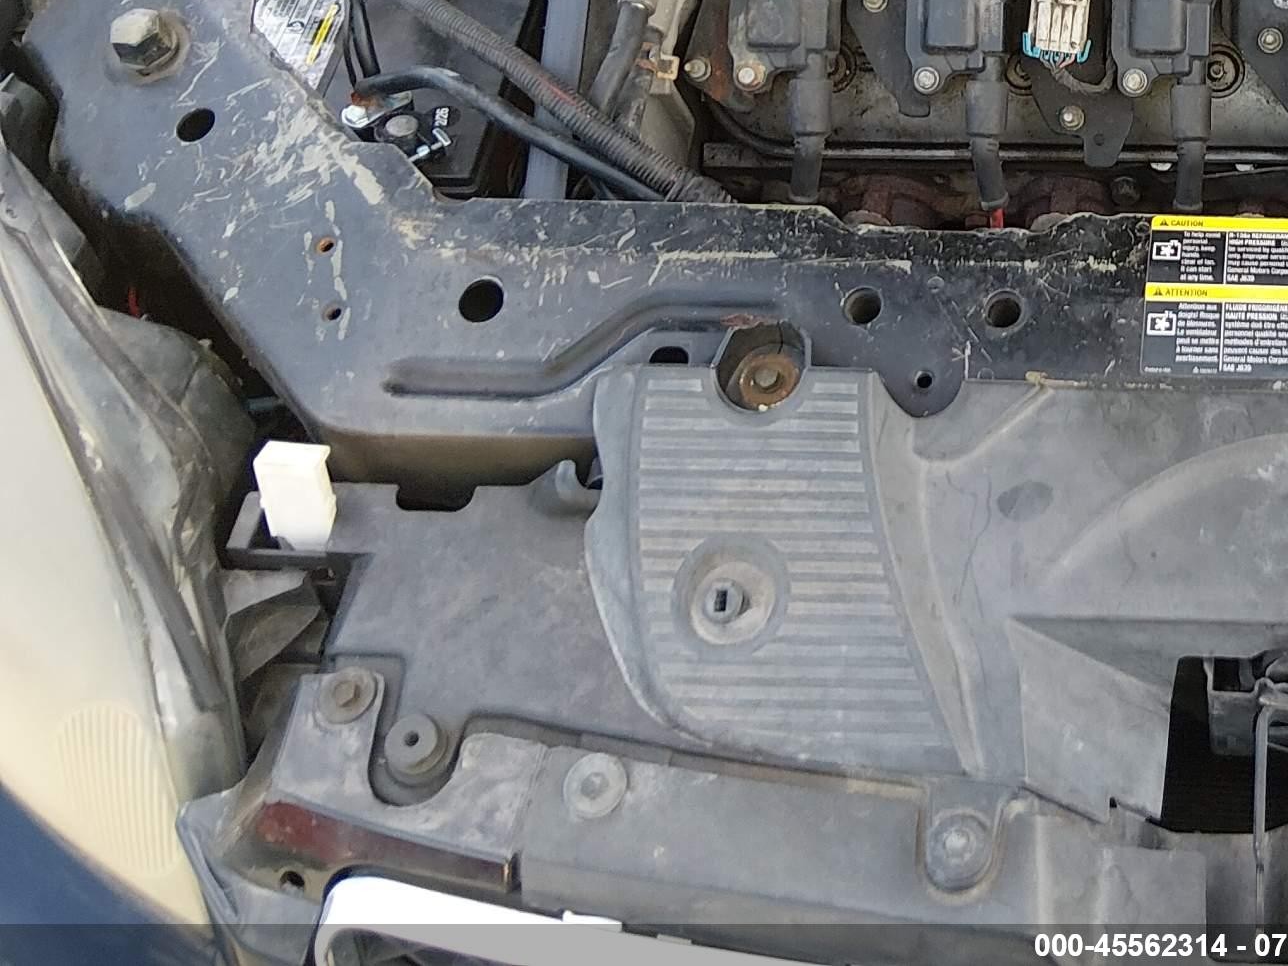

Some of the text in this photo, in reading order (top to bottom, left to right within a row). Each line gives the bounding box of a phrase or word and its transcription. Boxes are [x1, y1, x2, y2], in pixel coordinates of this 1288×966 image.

[1165, 288, 1207, 296] ATTENTION
[1225, 312, 1245, 320] HAUTE
[1246, 312, 1277, 321] PRESSION
[1246, 355, 1267, 363] Motors
